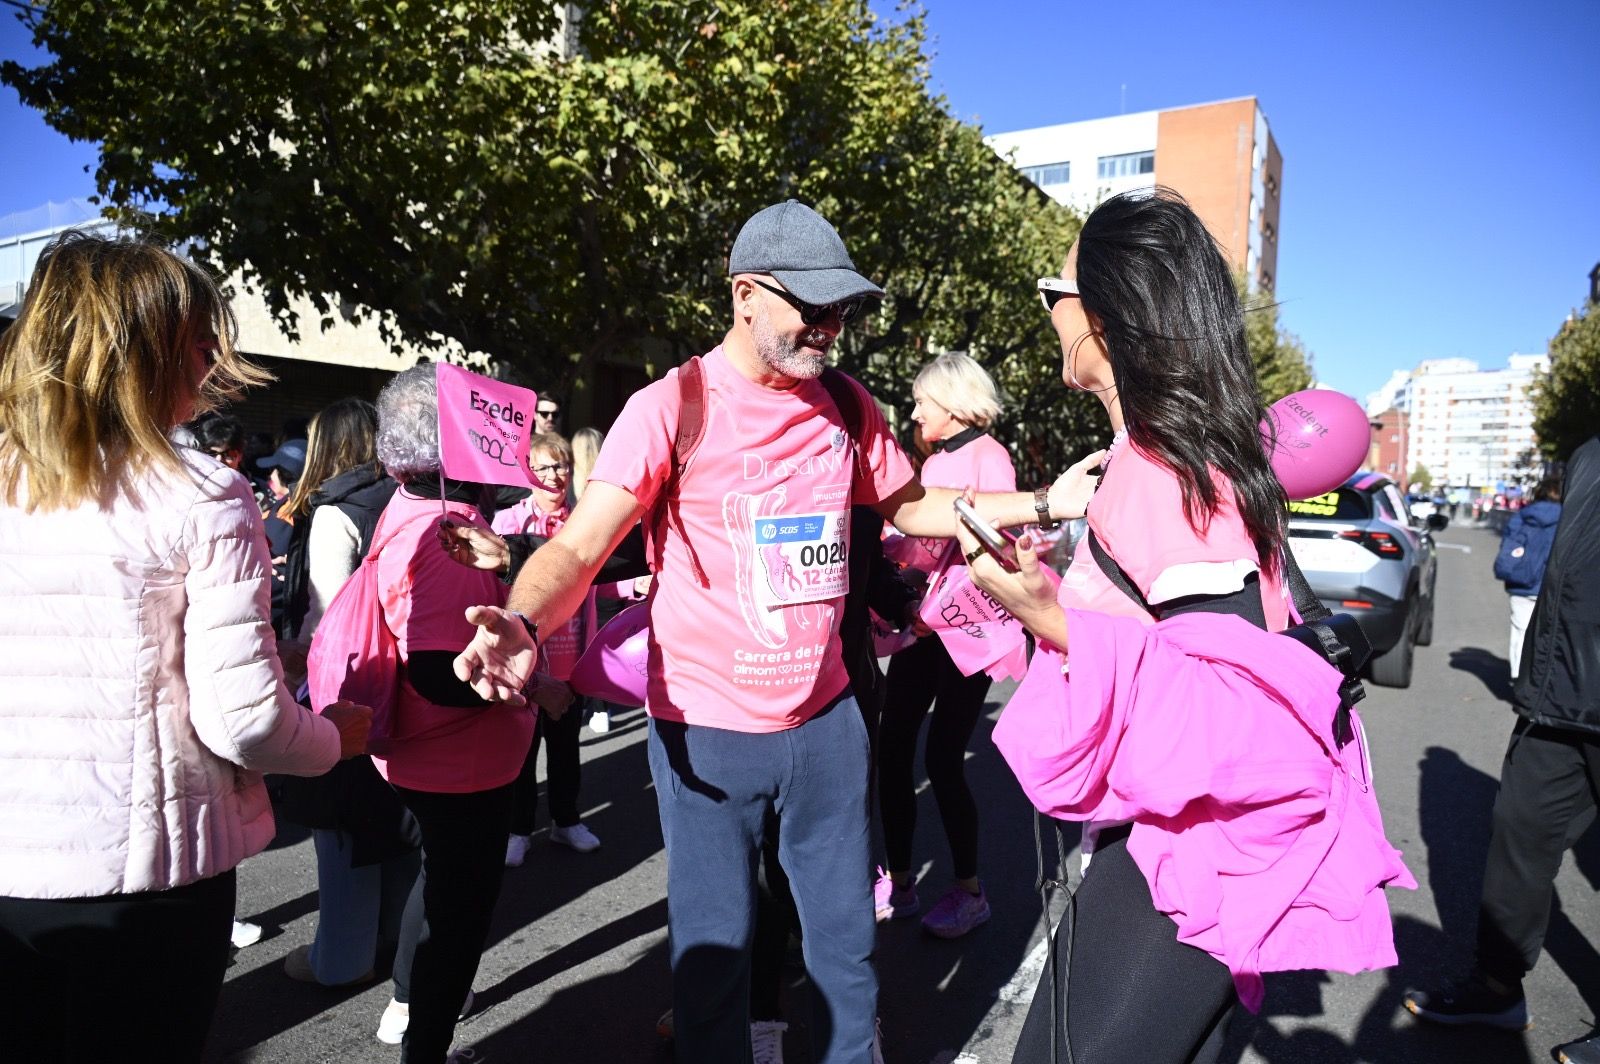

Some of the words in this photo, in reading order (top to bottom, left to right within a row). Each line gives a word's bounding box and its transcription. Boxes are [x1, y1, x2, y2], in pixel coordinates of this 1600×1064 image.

[470, 390, 527, 427] Ezede
[1284, 397, 1329, 438] Ezedent
[762, 524, 777, 539] hp
[734, 649, 791, 663] Carrera
[794, 646, 812, 659] de
[814, 643, 825, 656] la
[793, 661, 820, 673] DRA
[788, 674, 818, 685] cánce
